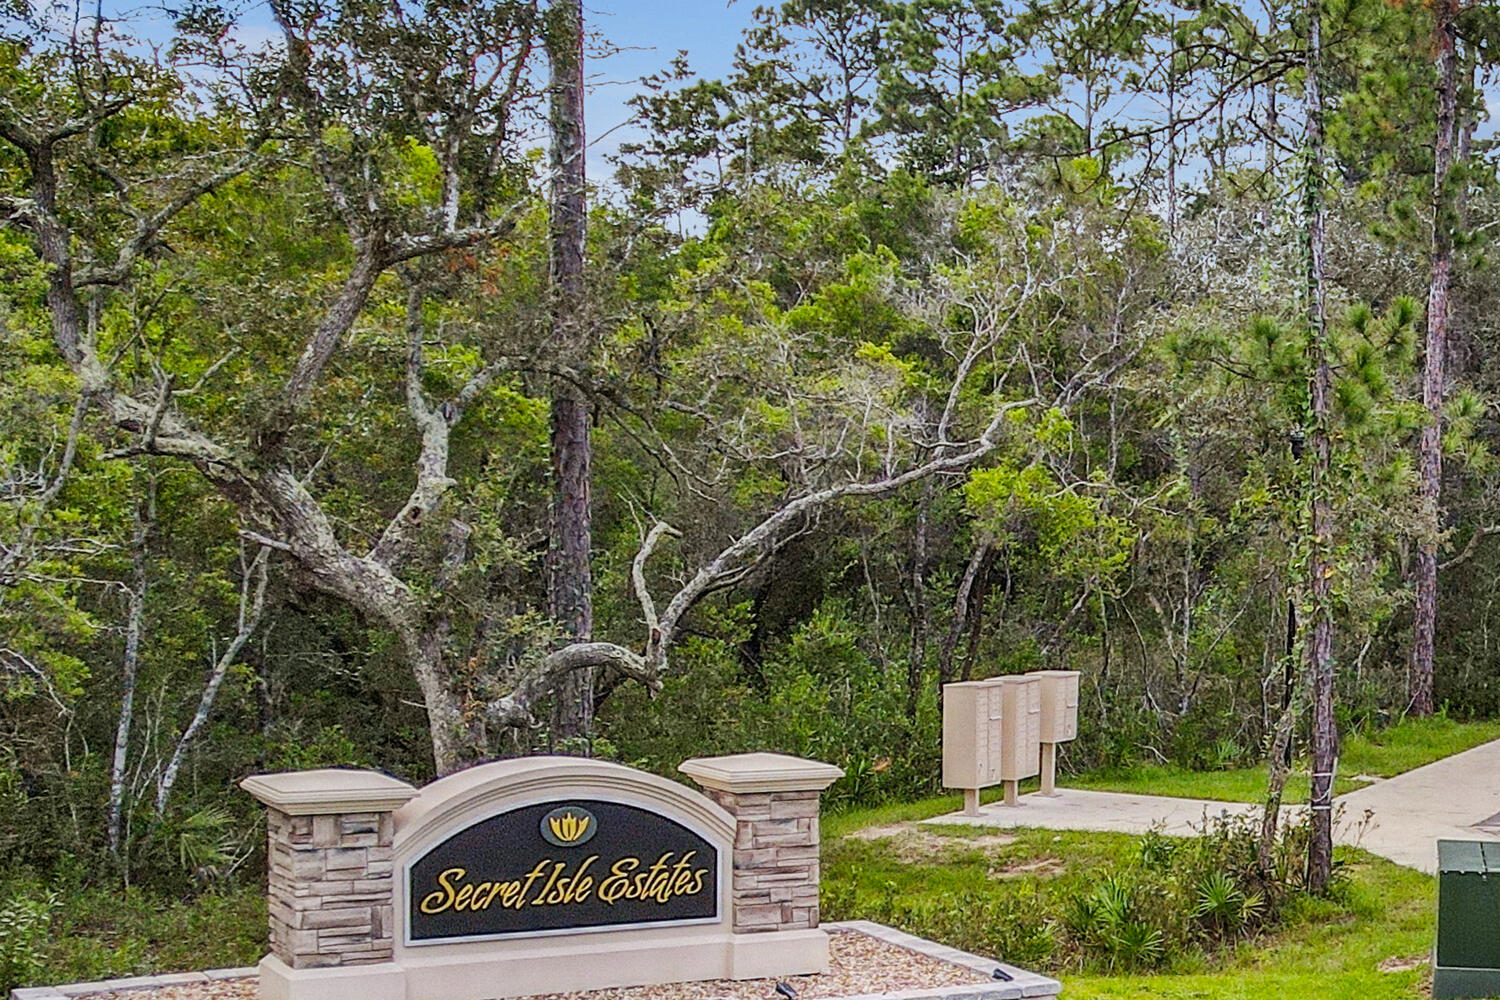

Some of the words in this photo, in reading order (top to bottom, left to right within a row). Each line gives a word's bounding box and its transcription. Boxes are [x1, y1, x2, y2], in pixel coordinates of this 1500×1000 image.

[420, 860, 550, 914] Secret
[532, 855, 599, 906] Isle
[598, 851, 709, 905] Estates
